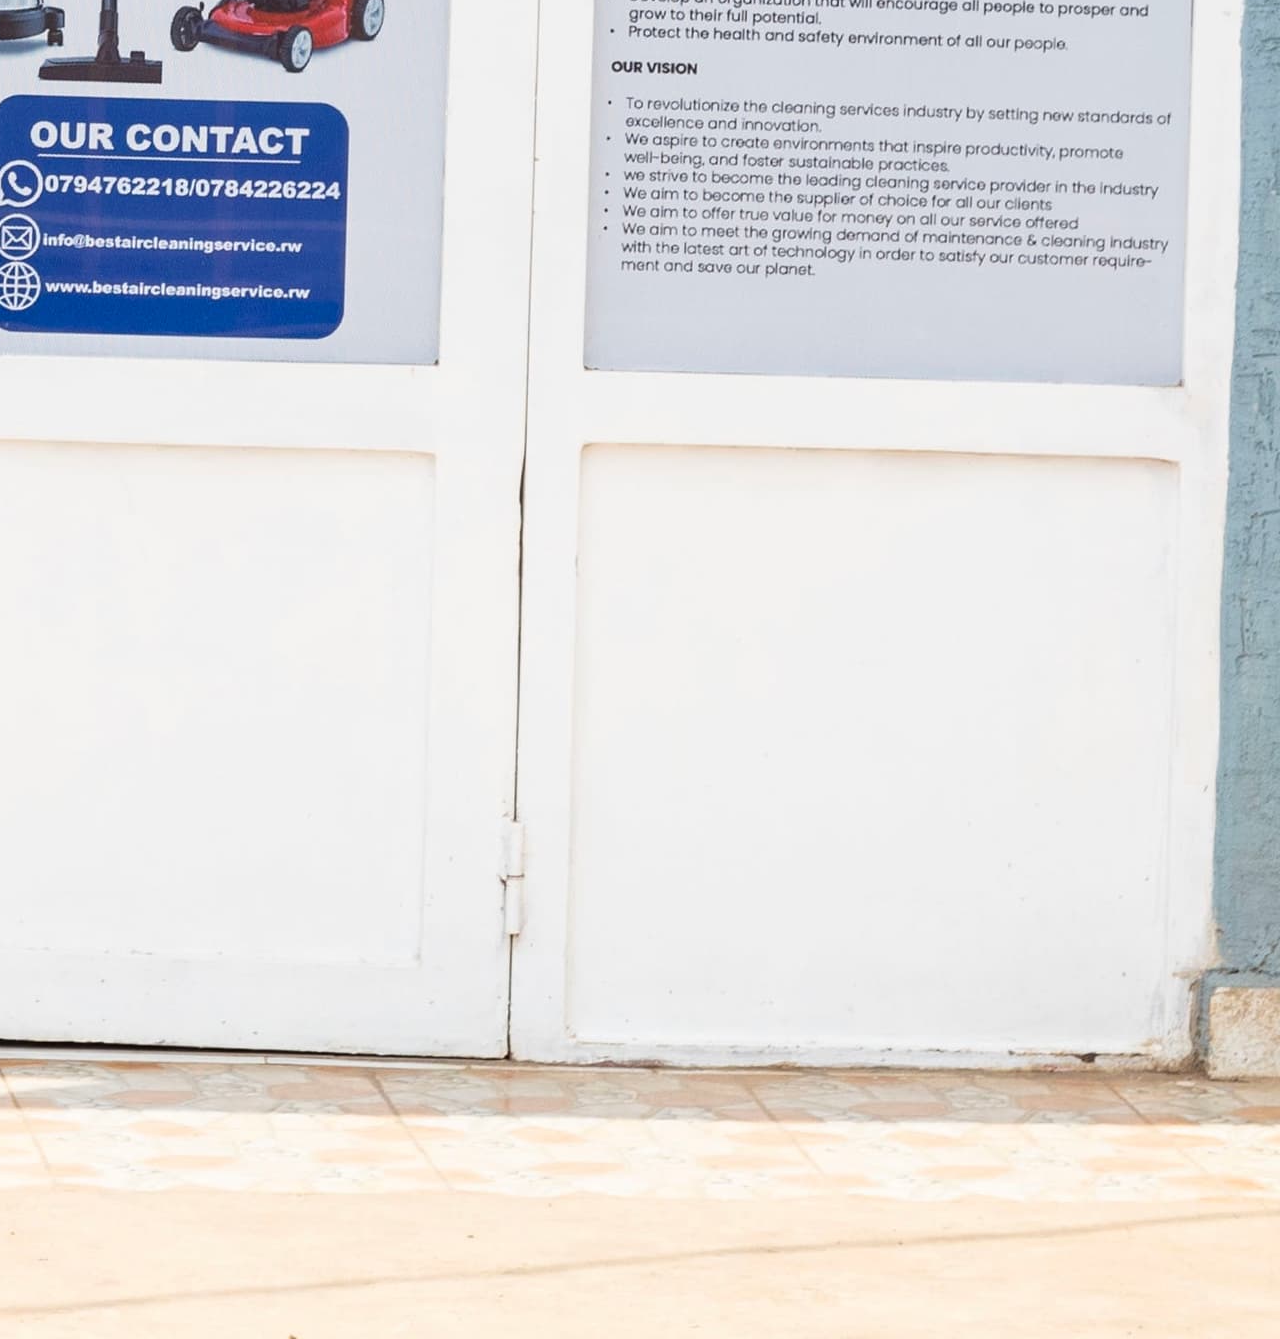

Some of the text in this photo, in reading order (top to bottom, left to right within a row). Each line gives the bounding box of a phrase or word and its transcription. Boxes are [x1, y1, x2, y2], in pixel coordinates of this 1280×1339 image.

[628, 24, 1068, 54] Protect the health and safety environment of all our people.
[611, 60, 698, 75] OUR VISION
[30, 121, 310, 155] OUR CONTACT
[44, 174, 341, 200] 0794762218/0784226224
[42, 232, 303, 254] info@bestaircleaningservice.rw
[44, 280, 311, 300] www.bestaircleaningservice.rw
